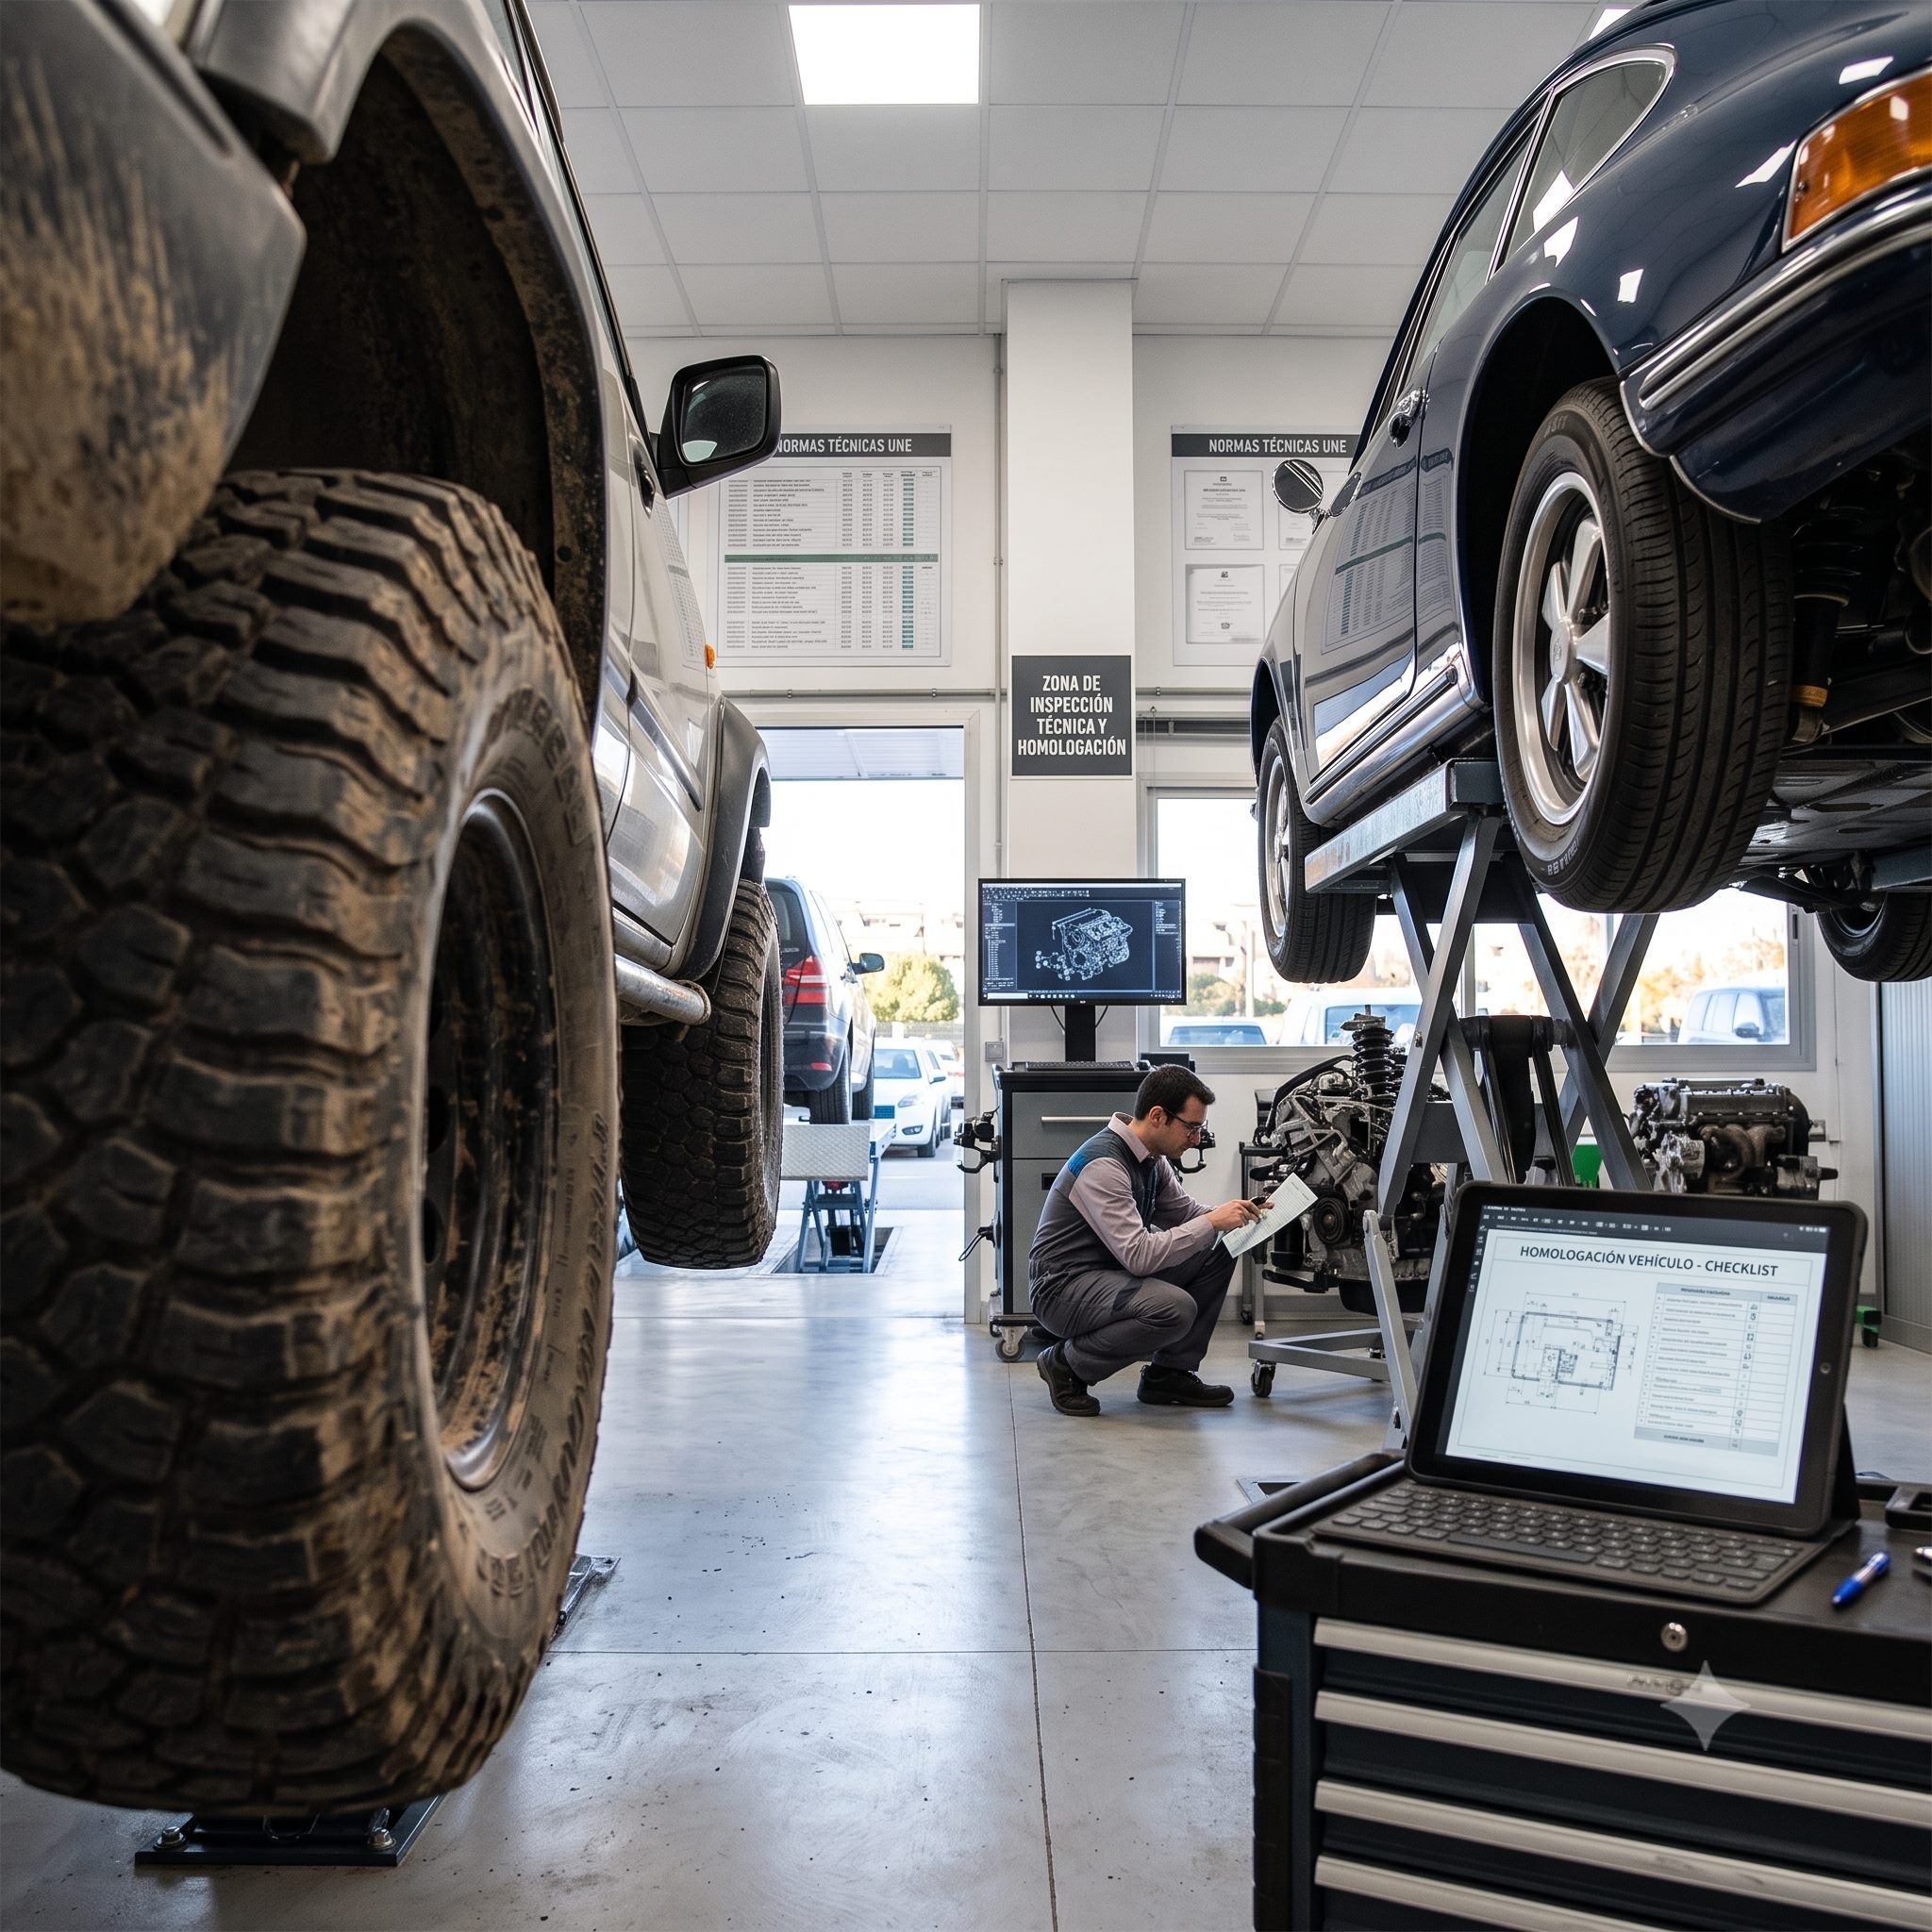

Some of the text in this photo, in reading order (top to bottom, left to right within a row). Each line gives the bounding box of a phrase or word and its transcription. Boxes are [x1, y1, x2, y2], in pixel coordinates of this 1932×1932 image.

[828, 436, 885, 453] TÉCNICAS
[888, 439, 912, 453] UNE
[1209, 437, 1347, 453] NORMAS TÉCNICAS UNE
[1042, 675, 1101, 691] ZONA DE
[1030, 693, 1113, 713] INSPECCIÓN
[1037, 715, 1108, 735] TÉCNICA Y
[1018, 736, 1126, 756] HOMOLOGACIÓN
[1520, 1245, 1625, 1265] HOMOLOGACIÓN
[1628, 1254, 1694, 1270] VEHÍCULO
[1705, 1259, 1779, 1276] CHECKLIST
